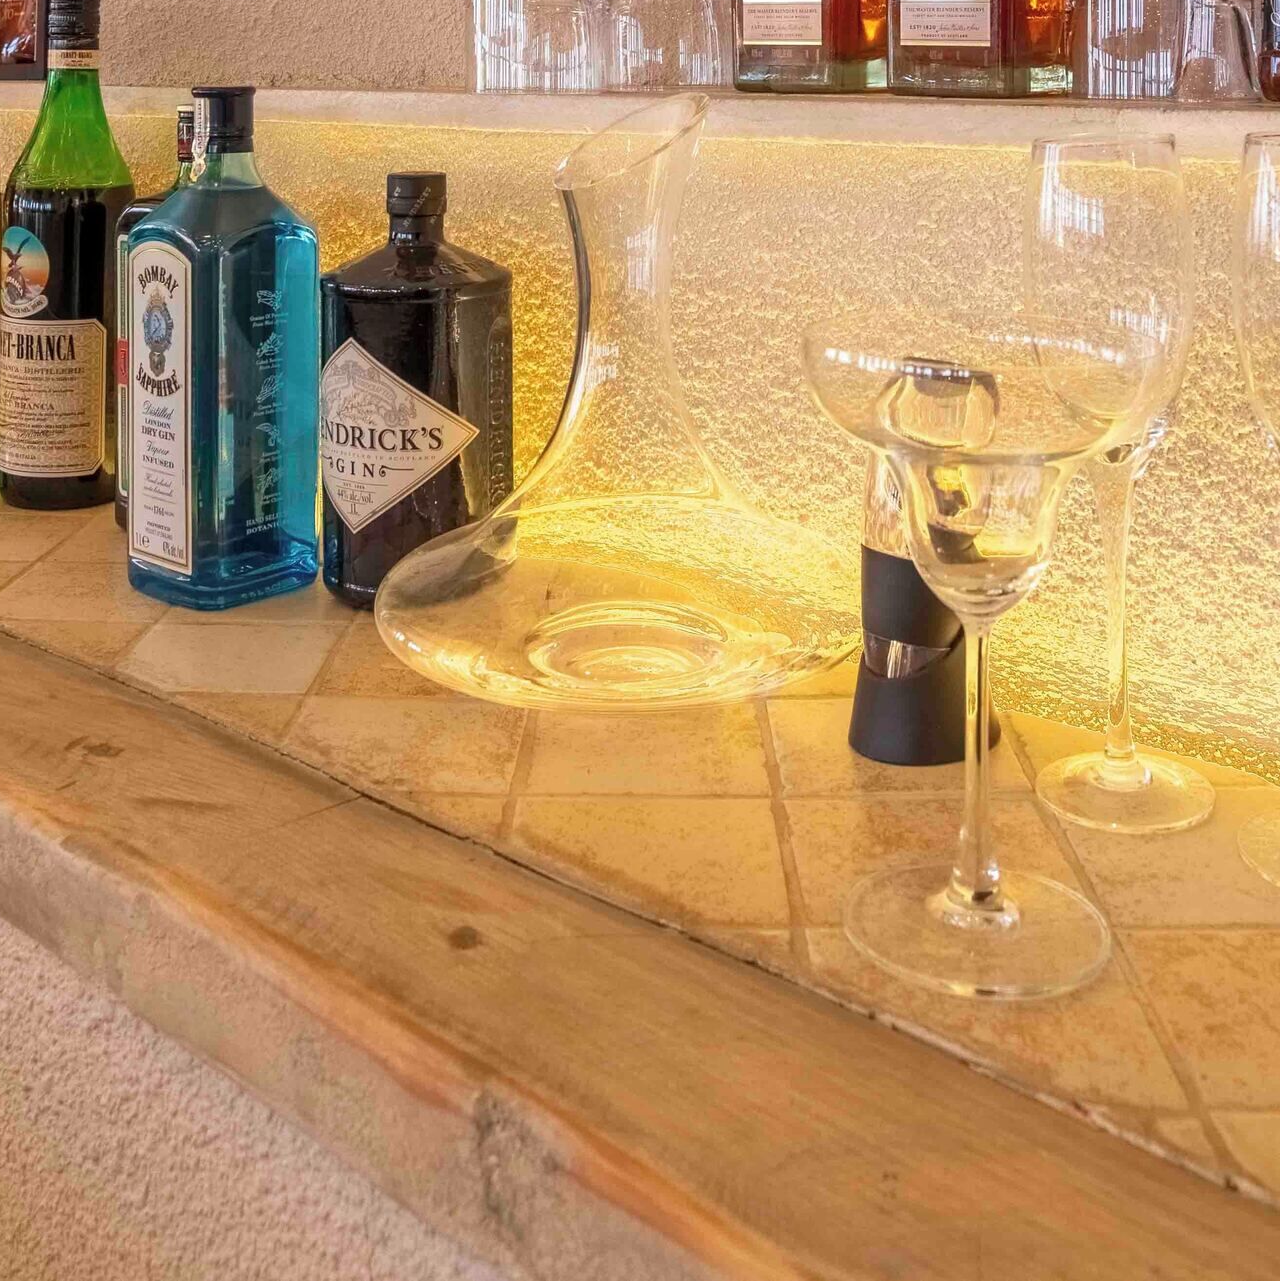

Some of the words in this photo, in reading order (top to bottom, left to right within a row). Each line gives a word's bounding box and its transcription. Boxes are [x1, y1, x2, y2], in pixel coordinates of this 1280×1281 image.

[137, 265, 179, 299] BOMBAY
[135, 363, 181, 398] SAPPHIRE
[14, 402, 55, 411] BRANCA
[142, 399, 175, 421] Distilled
[141, 425, 157, 438] DRY
[159, 427, 176, 441] GIN
[144, 417, 172, 430] LONDON
[321, 417, 443, 452] NDRICK'S
[142, 454, 175, 469] INFUSED
[336, 457, 375, 478] GIN
